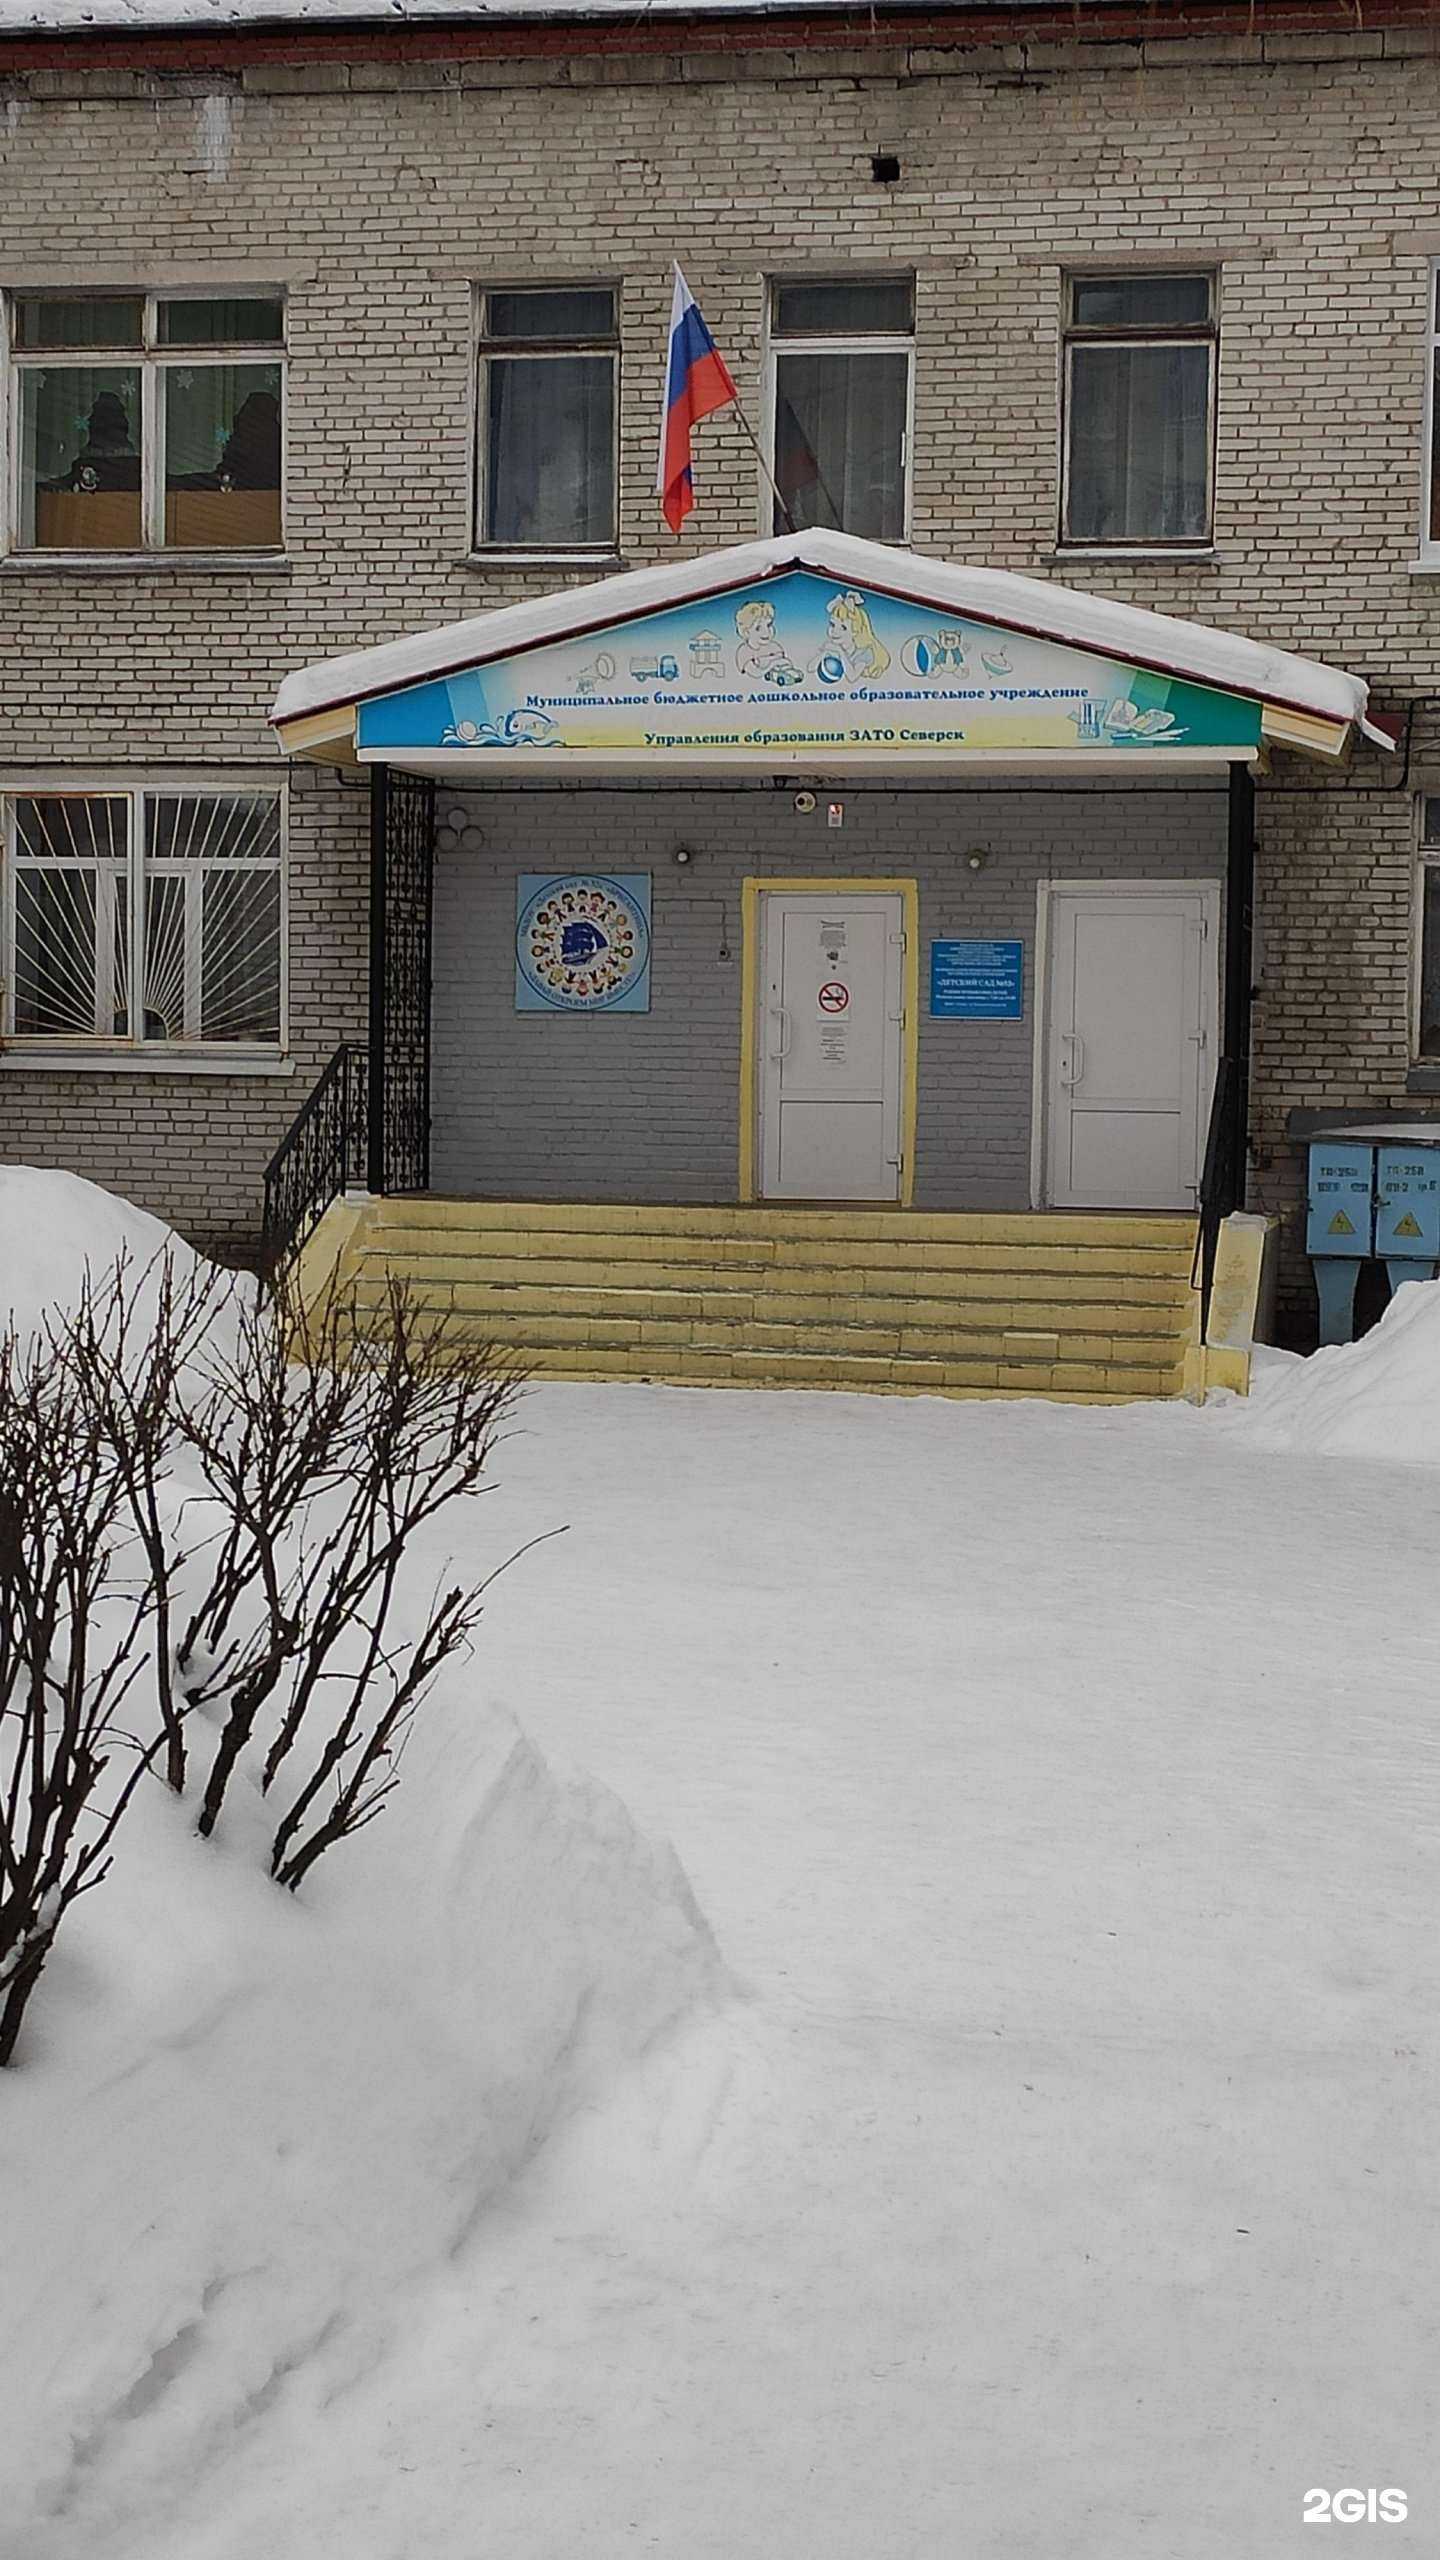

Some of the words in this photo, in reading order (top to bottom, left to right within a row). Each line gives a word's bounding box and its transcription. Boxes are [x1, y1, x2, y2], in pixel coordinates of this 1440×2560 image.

[526, 694, 649, 708] Муниципальное
[653, 691, 743, 705] бюджетное
[747, 690, 845, 704] дошкольное
[849, 687, 984, 702] образовательное
[989, 687, 1090, 704] учреждение
[643, 732, 739, 748] Управления
[743, 730, 845, 747] образования
[849, 728, 895, 743] ЗАТО
[899, 728, 965, 744] Северск
